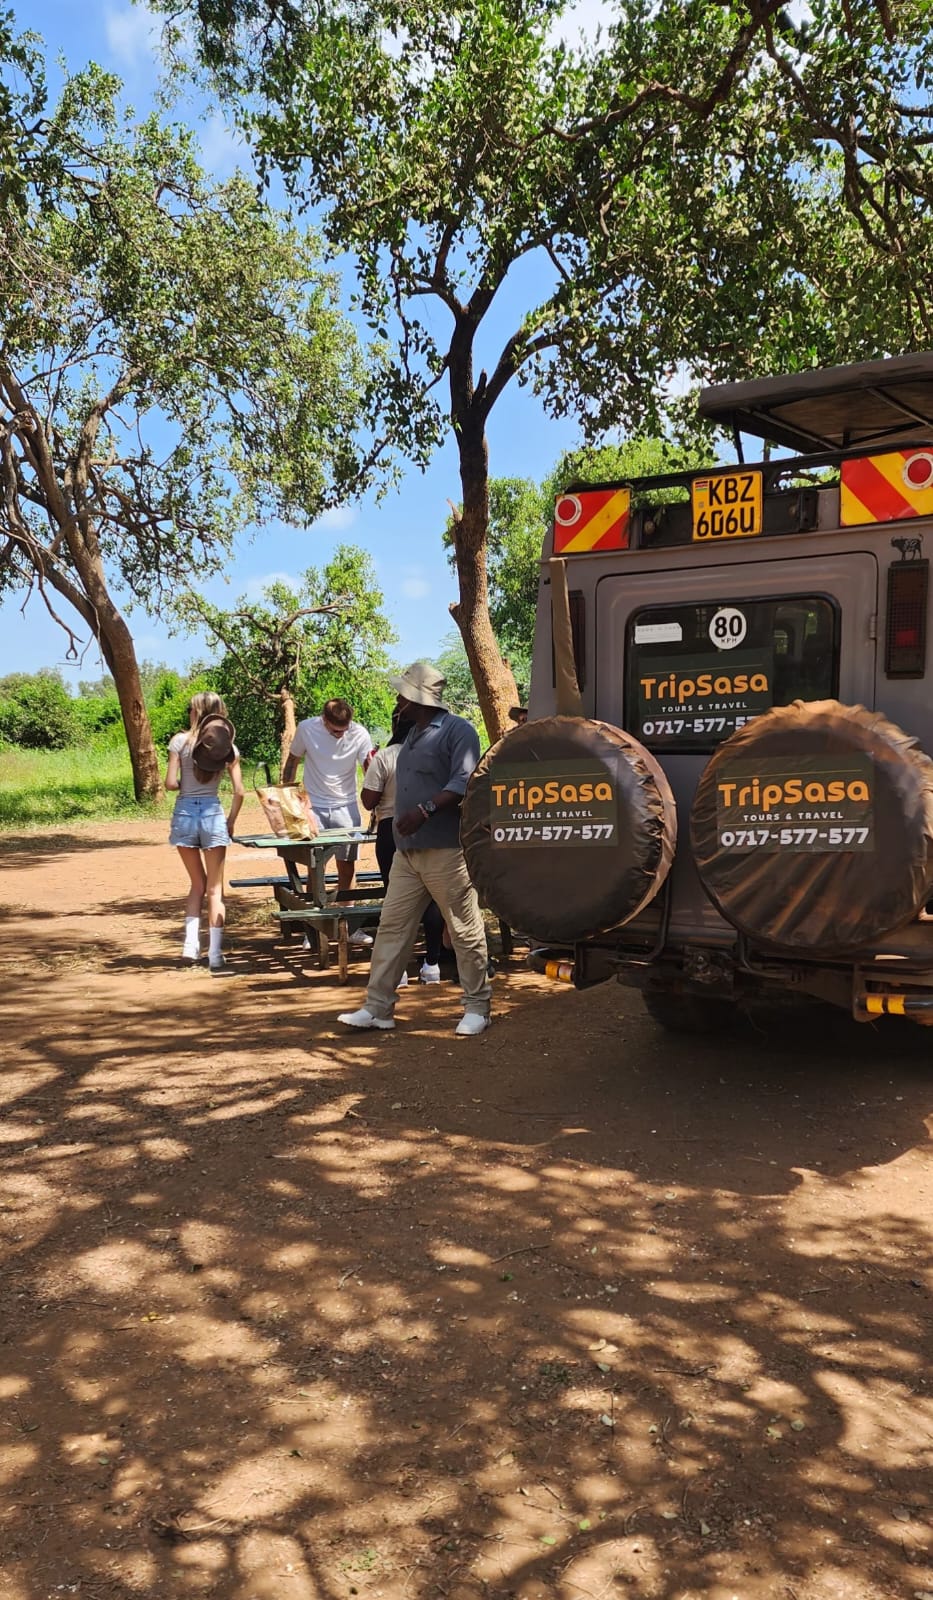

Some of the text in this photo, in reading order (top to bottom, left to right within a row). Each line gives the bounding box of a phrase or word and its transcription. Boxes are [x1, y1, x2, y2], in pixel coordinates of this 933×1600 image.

[709, 475, 755, 506] KBZ
[696, 506, 755, 537] 606U
[715, 615, 742, 638] 80
[640, 673, 769, 704] TripSasa
[662, 705, 693, 713] TOURS
[709, 701, 748, 710] TRAVEL
[643, 716, 761, 735] 0717-577-5
[491, 780, 614, 811] TripSasa
[718, 777, 870, 812] TripSasa
[512, 812, 541, 820] TOURS
[556, 810, 593, 818] TRAVEL
[743, 813, 780, 822] TOURS
[798, 811, 844, 820] TRAVEL
[494, 824, 614, 842] 0717-577-577
[720, 827, 870, 847] 0717-577-577
